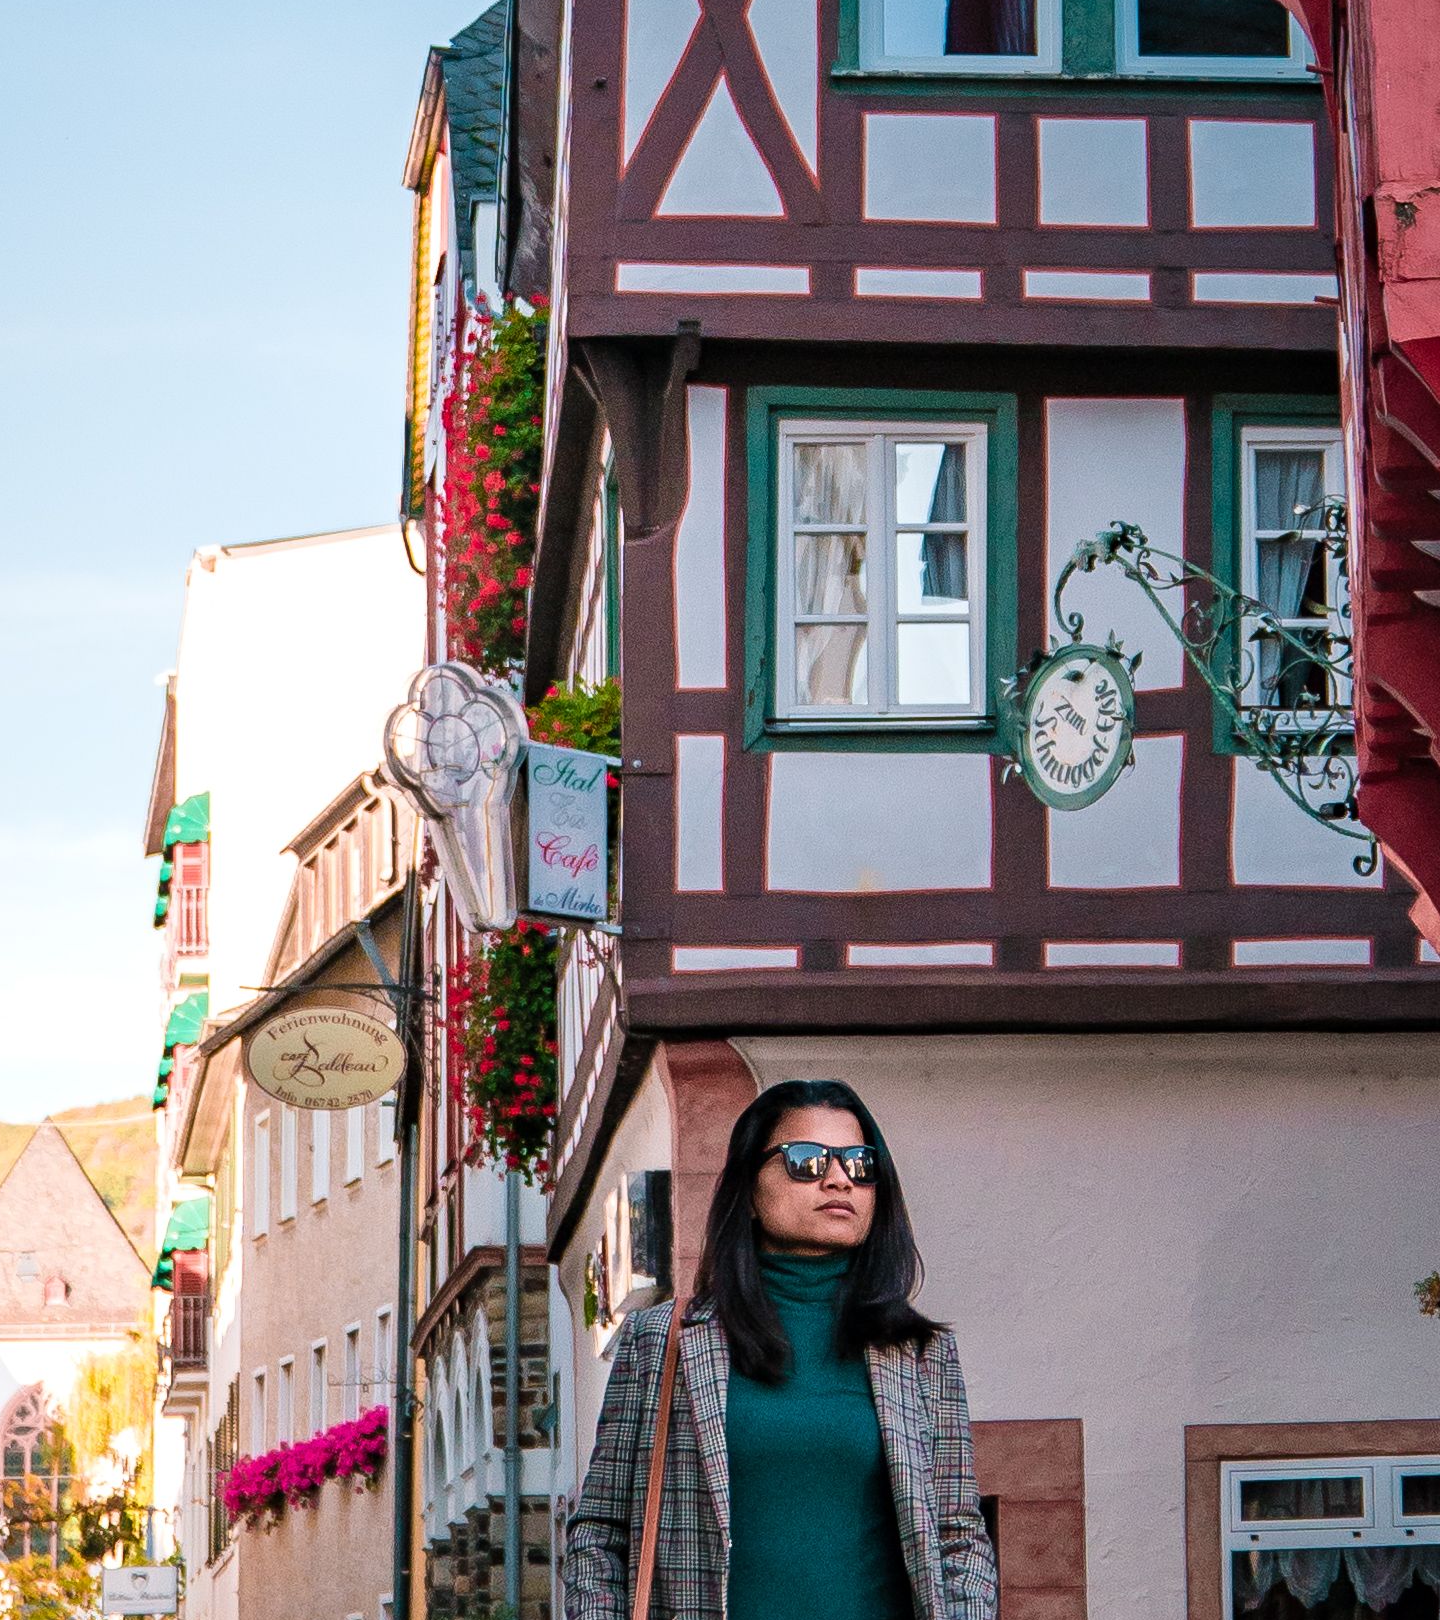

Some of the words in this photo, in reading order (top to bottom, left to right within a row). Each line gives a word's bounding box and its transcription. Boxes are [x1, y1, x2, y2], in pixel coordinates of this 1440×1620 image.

[533, 758, 603, 794] Ital
[546, 887, 603, 915] Mirko
[266, 1013, 389, 1047] Ferienwohnung
[274, 1086, 298, 1103] Info
